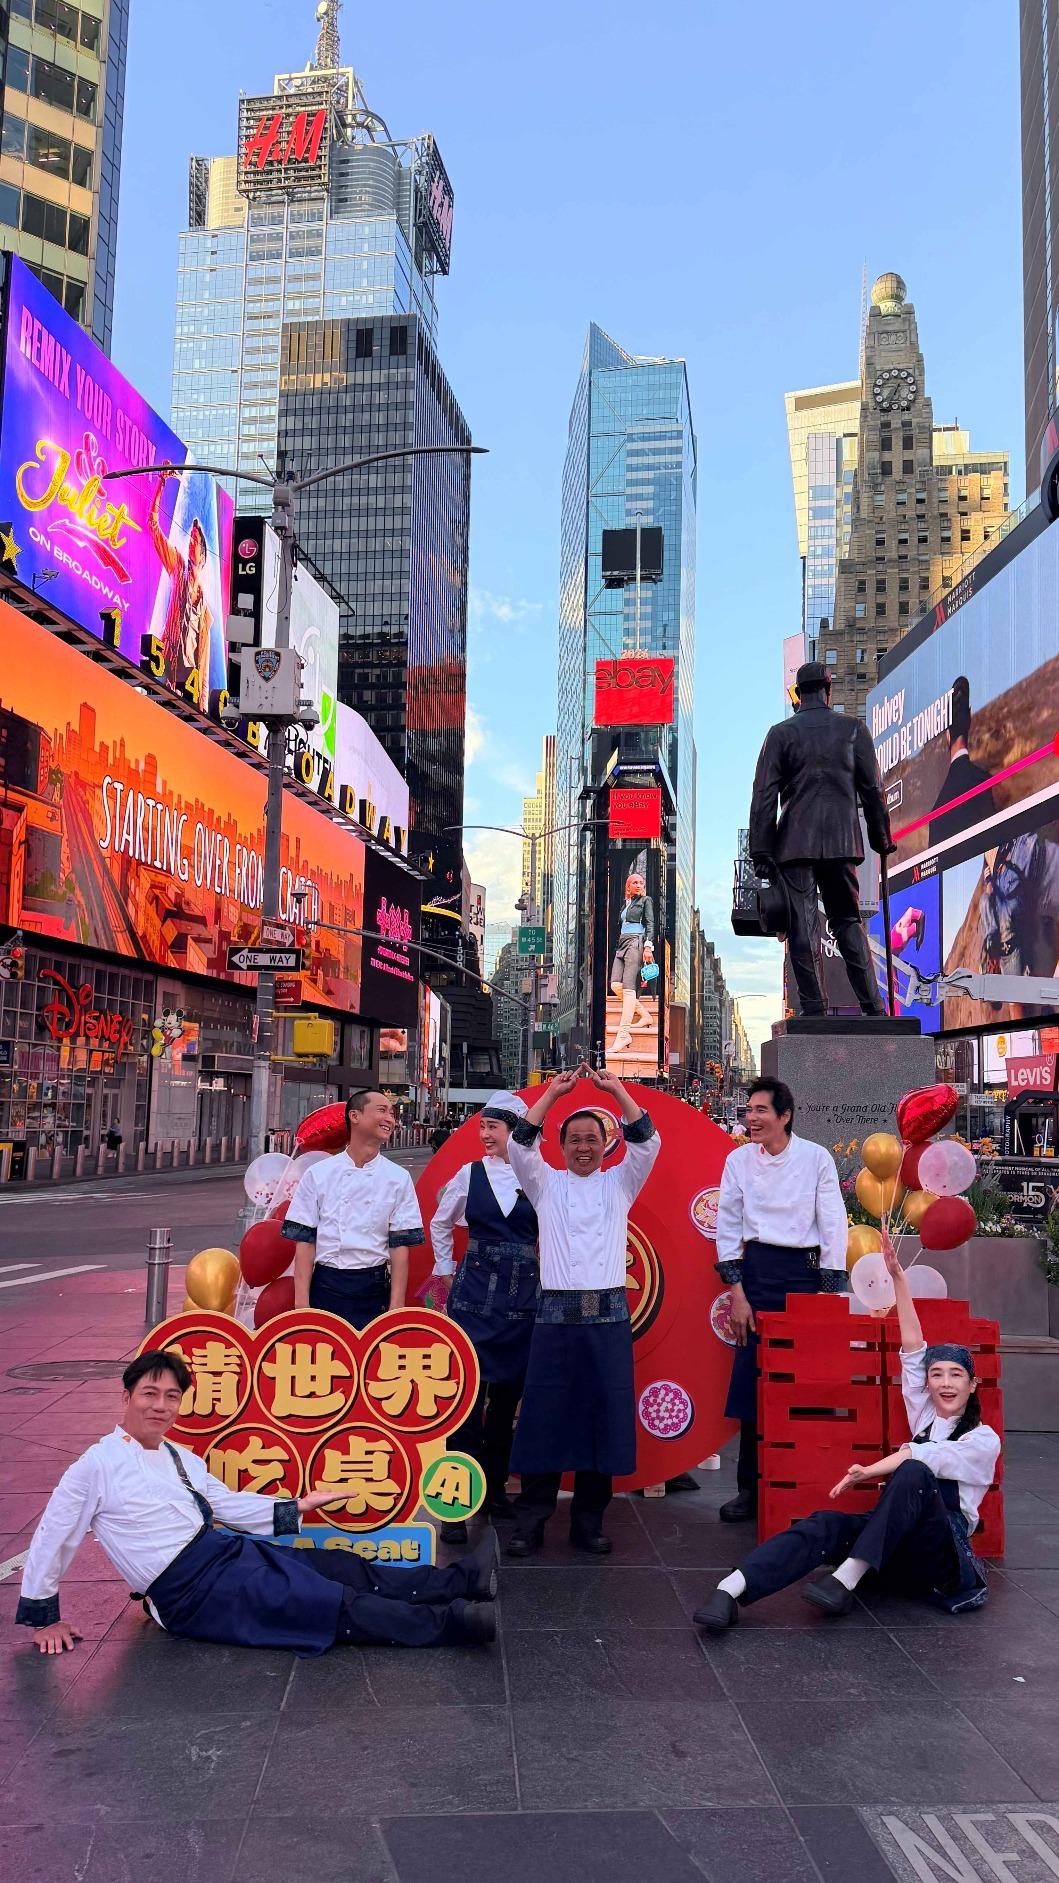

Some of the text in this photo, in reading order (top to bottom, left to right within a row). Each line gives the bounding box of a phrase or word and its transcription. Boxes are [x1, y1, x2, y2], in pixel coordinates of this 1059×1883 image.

[242, 109, 326, 169] H&M
[20, 305, 157, 484] REMIX YOUR STORY
[16, 439, 141, 549] Juliet
[28, 527, 130, 612] ON BROADWAY
[238, 563, 256, 575] LG
[900, 721, 911, 763] BE
[912, 688, 954, 751] TONIGHT
[99, 775, 188, 881] STARTING
[193, 823, 229, 897] OVER
[265, 927, 290, 941] ONE WAY
[238, 951, 291, 966] ONE WAY
[834, 1114, 879, 1124] Over There
[841, 1104, 868, 1114] Grand
[870, 1103, 886, 1113] Old
[1021, 1182, 1046, 1208] 15
[323, 1537, 420, 1562] Seat
